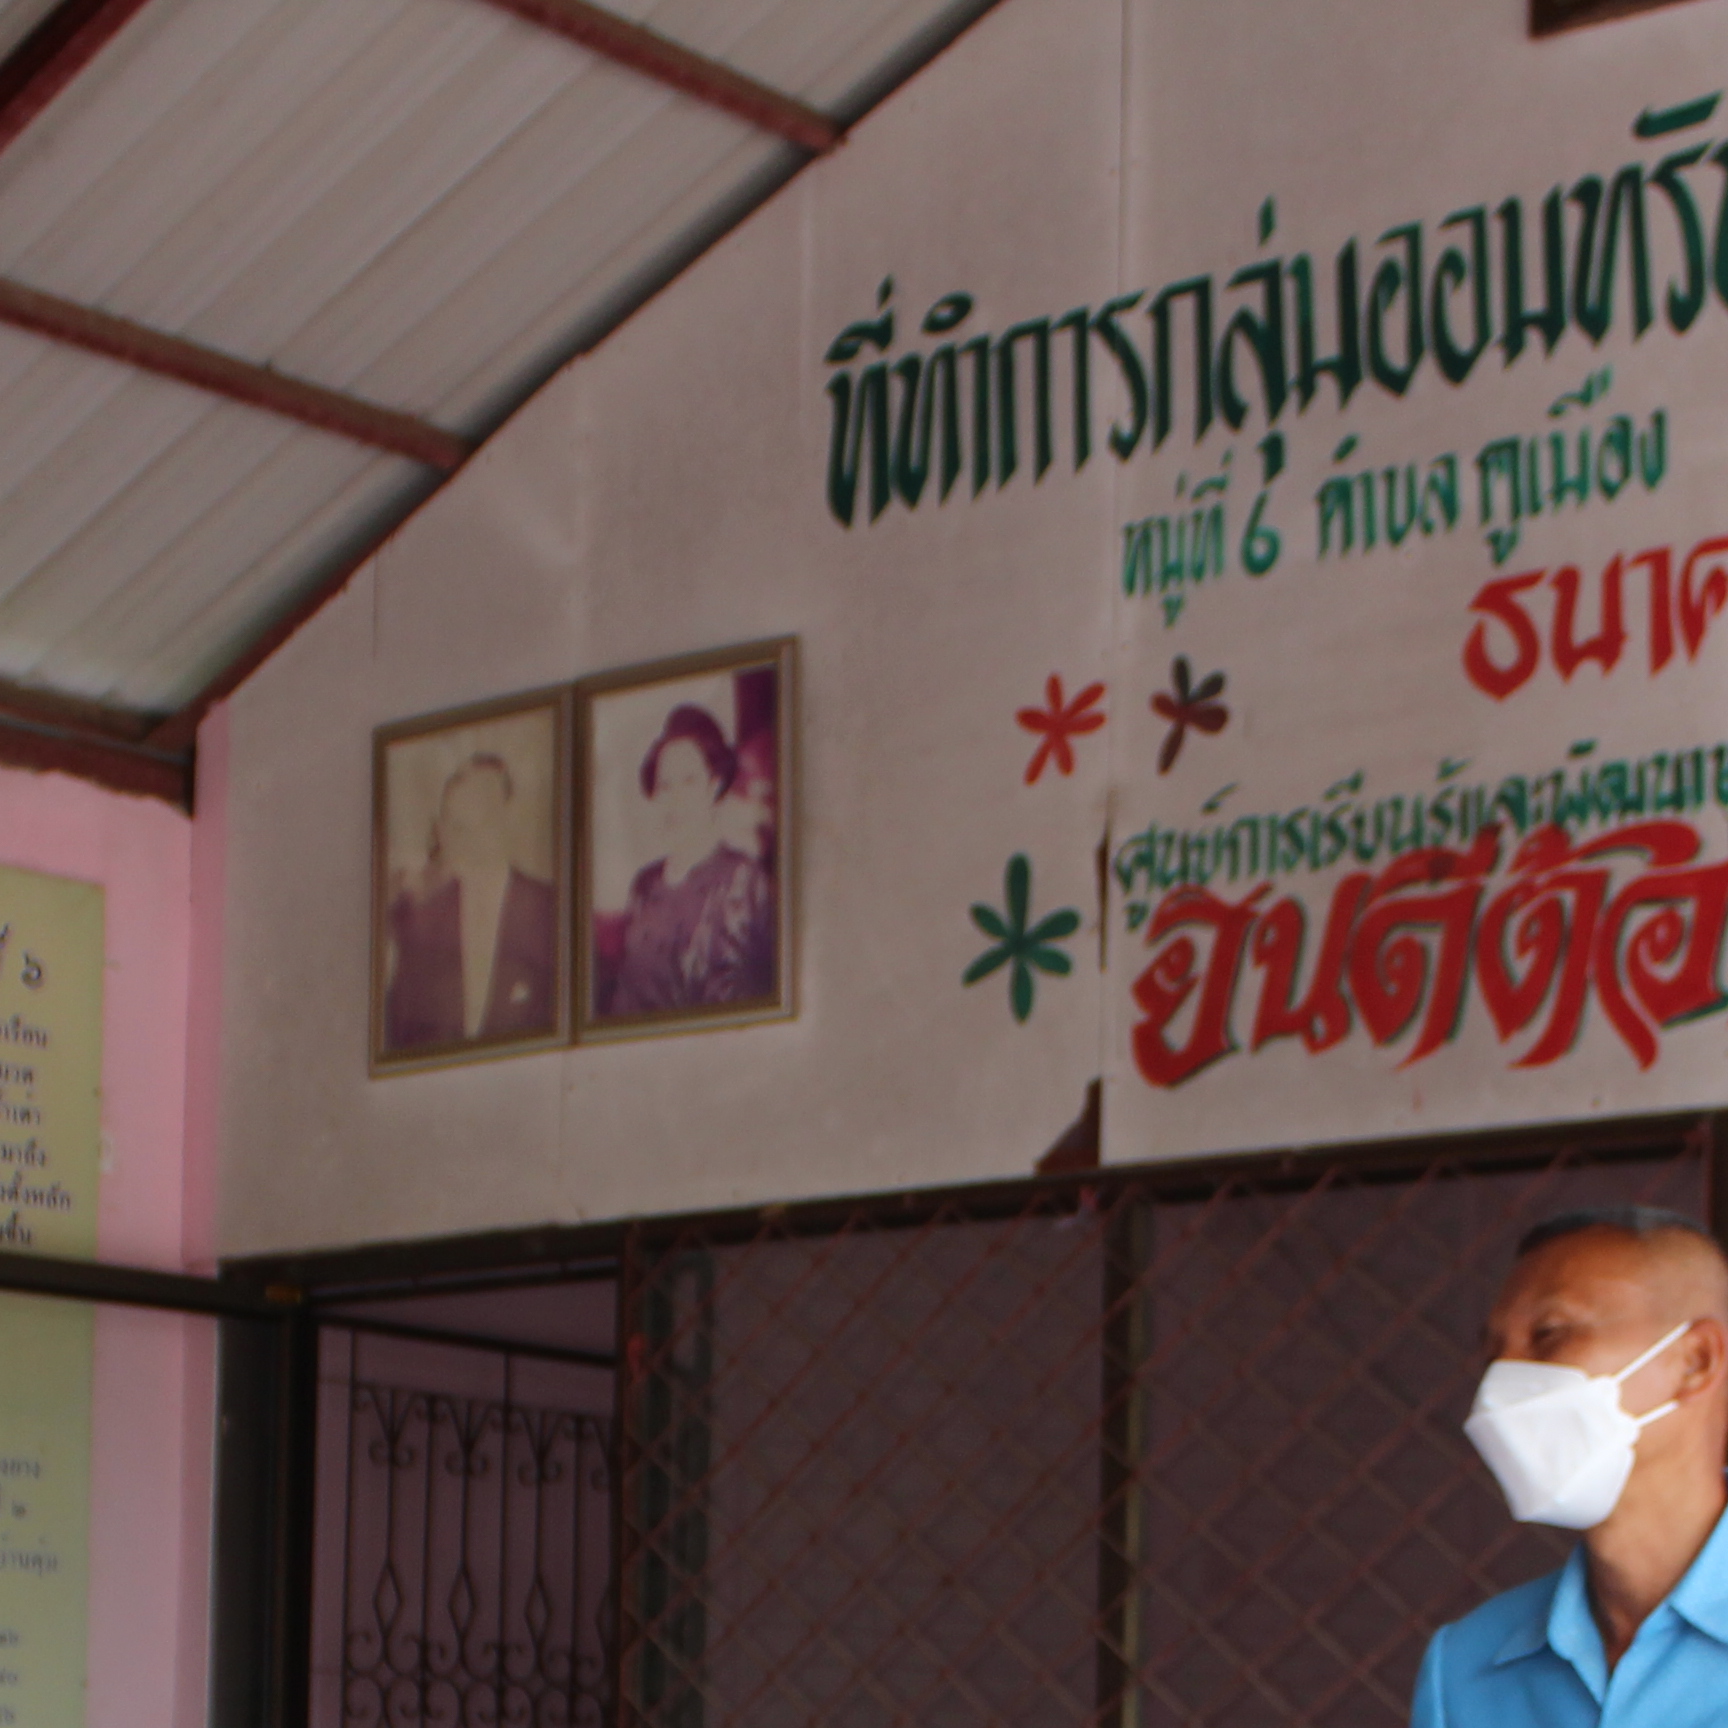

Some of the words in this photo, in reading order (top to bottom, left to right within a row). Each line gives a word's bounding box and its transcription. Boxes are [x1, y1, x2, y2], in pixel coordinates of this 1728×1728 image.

[1123, 447, 1230, 629] หมู่ที่
[1315, 432, 1462, 560] ตำบล
[1476, 363, 1668, 566] คูเมือง
